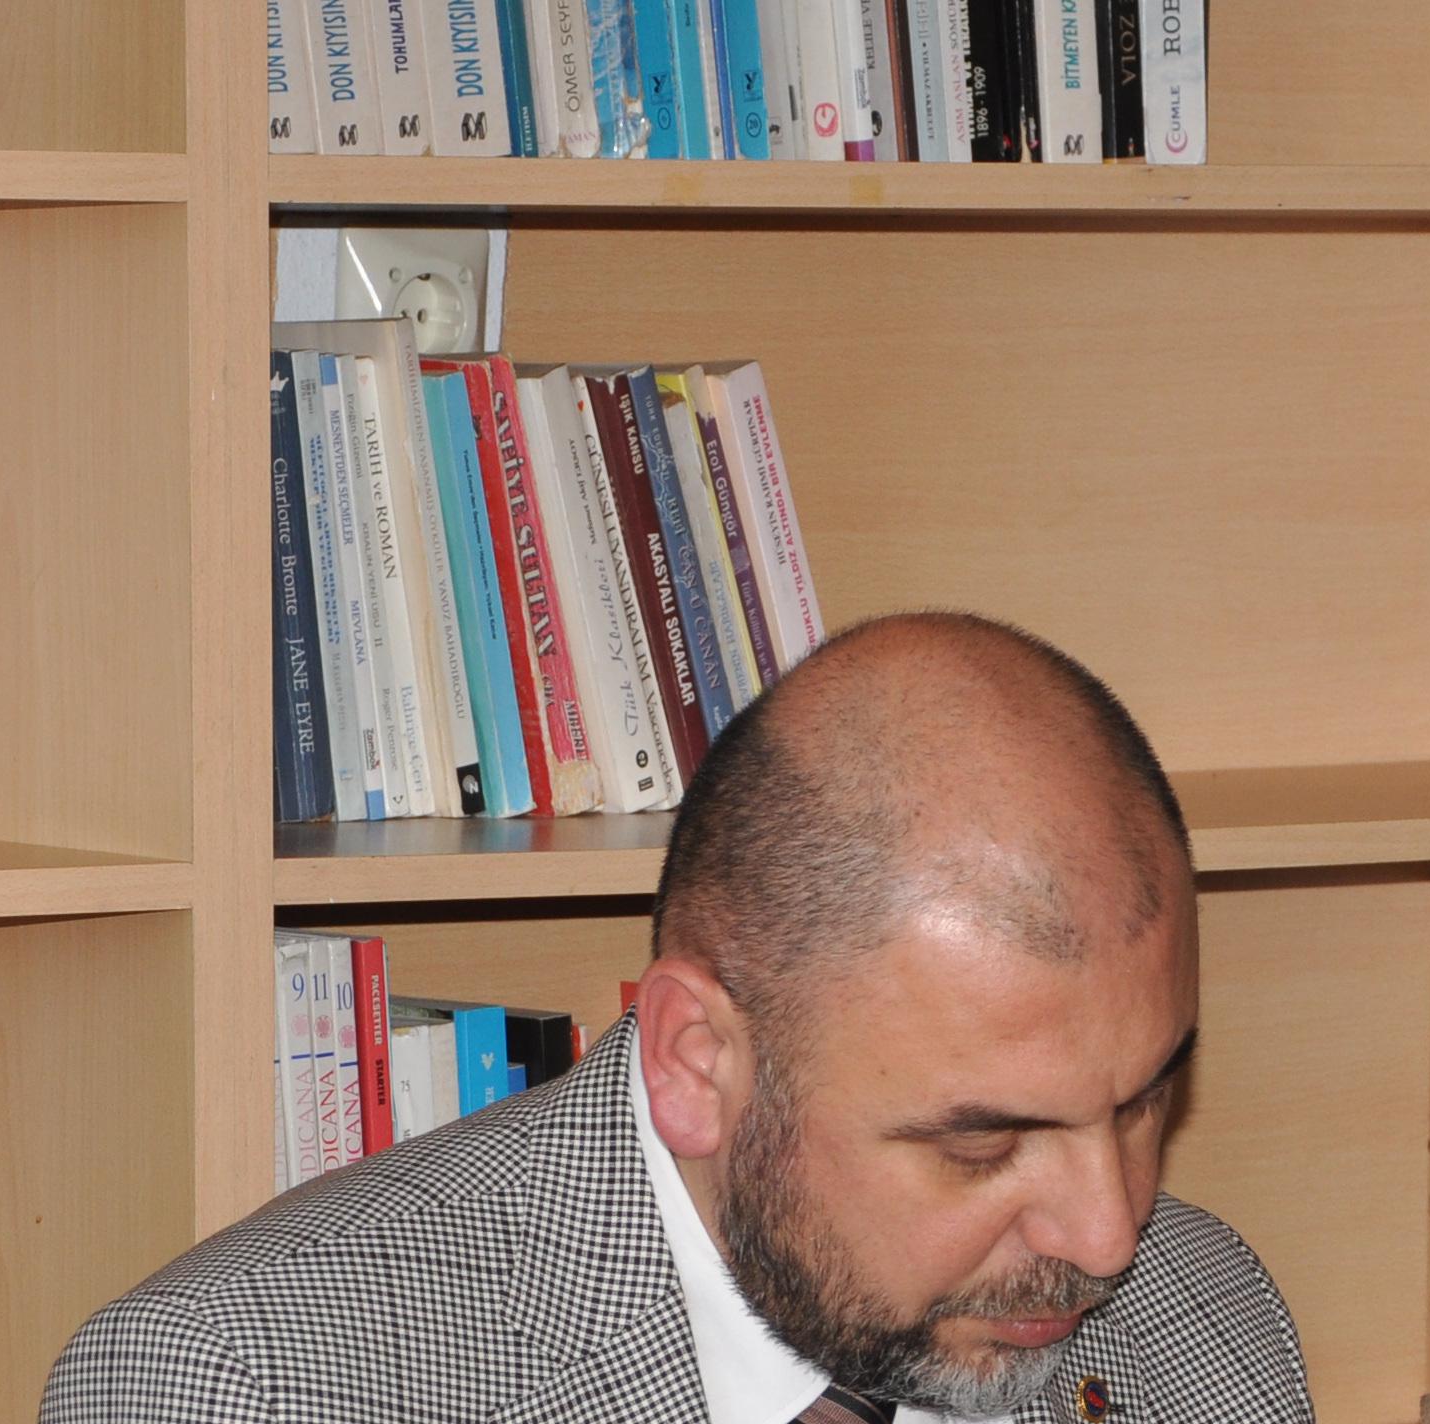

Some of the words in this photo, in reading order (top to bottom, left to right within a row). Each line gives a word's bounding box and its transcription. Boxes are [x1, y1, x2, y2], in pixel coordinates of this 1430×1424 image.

[1061, 12, 1082, 90] BİTMEYEN
[332, 63, 355, 102] DON
[456, 58, 482, 98] DON
[559, 52, 582, 113] ÖMER
[974, 66, 986, 95] 1909
[977, 107, 989, 137] 1896
[364, 413, 385, 476] TARİH
[743, 399, 763, 464] GÜRPINAR
[754, 394, 774, 458] EVLENME
[351, 436, 363, 479] Gizemi
[706, 440, 723, 473] Erol
[766, 462, 781, 486] BİR
[271, 457, 292, 545] Charlotte
[372, 481, 385, 502] ve
[714, 478, 739, 539] Güngör
[756, 465, 773, 509] RAHMİ
[339, 487, 355, 546] SEÇMELER
[773, 488, 796, 546] ALTINDA
[376, 506, 396, 580] ROMAN
[619, 393, 633, 425] IŞIK
[626, 427, 644, 474] KANSU
[646, 532, 672, 615] AKASYALI
[666, 618, 696, 706] SOKAKLAR
[281, 554, 298, 616] Bronte
[516, 524, 556, 658] SULTAN
[788, 551, 806, 594] YILDIZ
[436, 578, 452, 622] YAVUZ
[288, 635, 310, 692] JANE
[296, 701, 315, 754] EYRE
[378, 687, 395, 723] Roger
[384, 725, 401, 772] Penrose
[291, 973, 305, 1001] 9
[312, 972, 329, 1000] 11
[336, 982, 352, 1011] 10
[370, 974, 383, 1046] PACESETTER
[375, 1058, 386, 1107] STARTER
